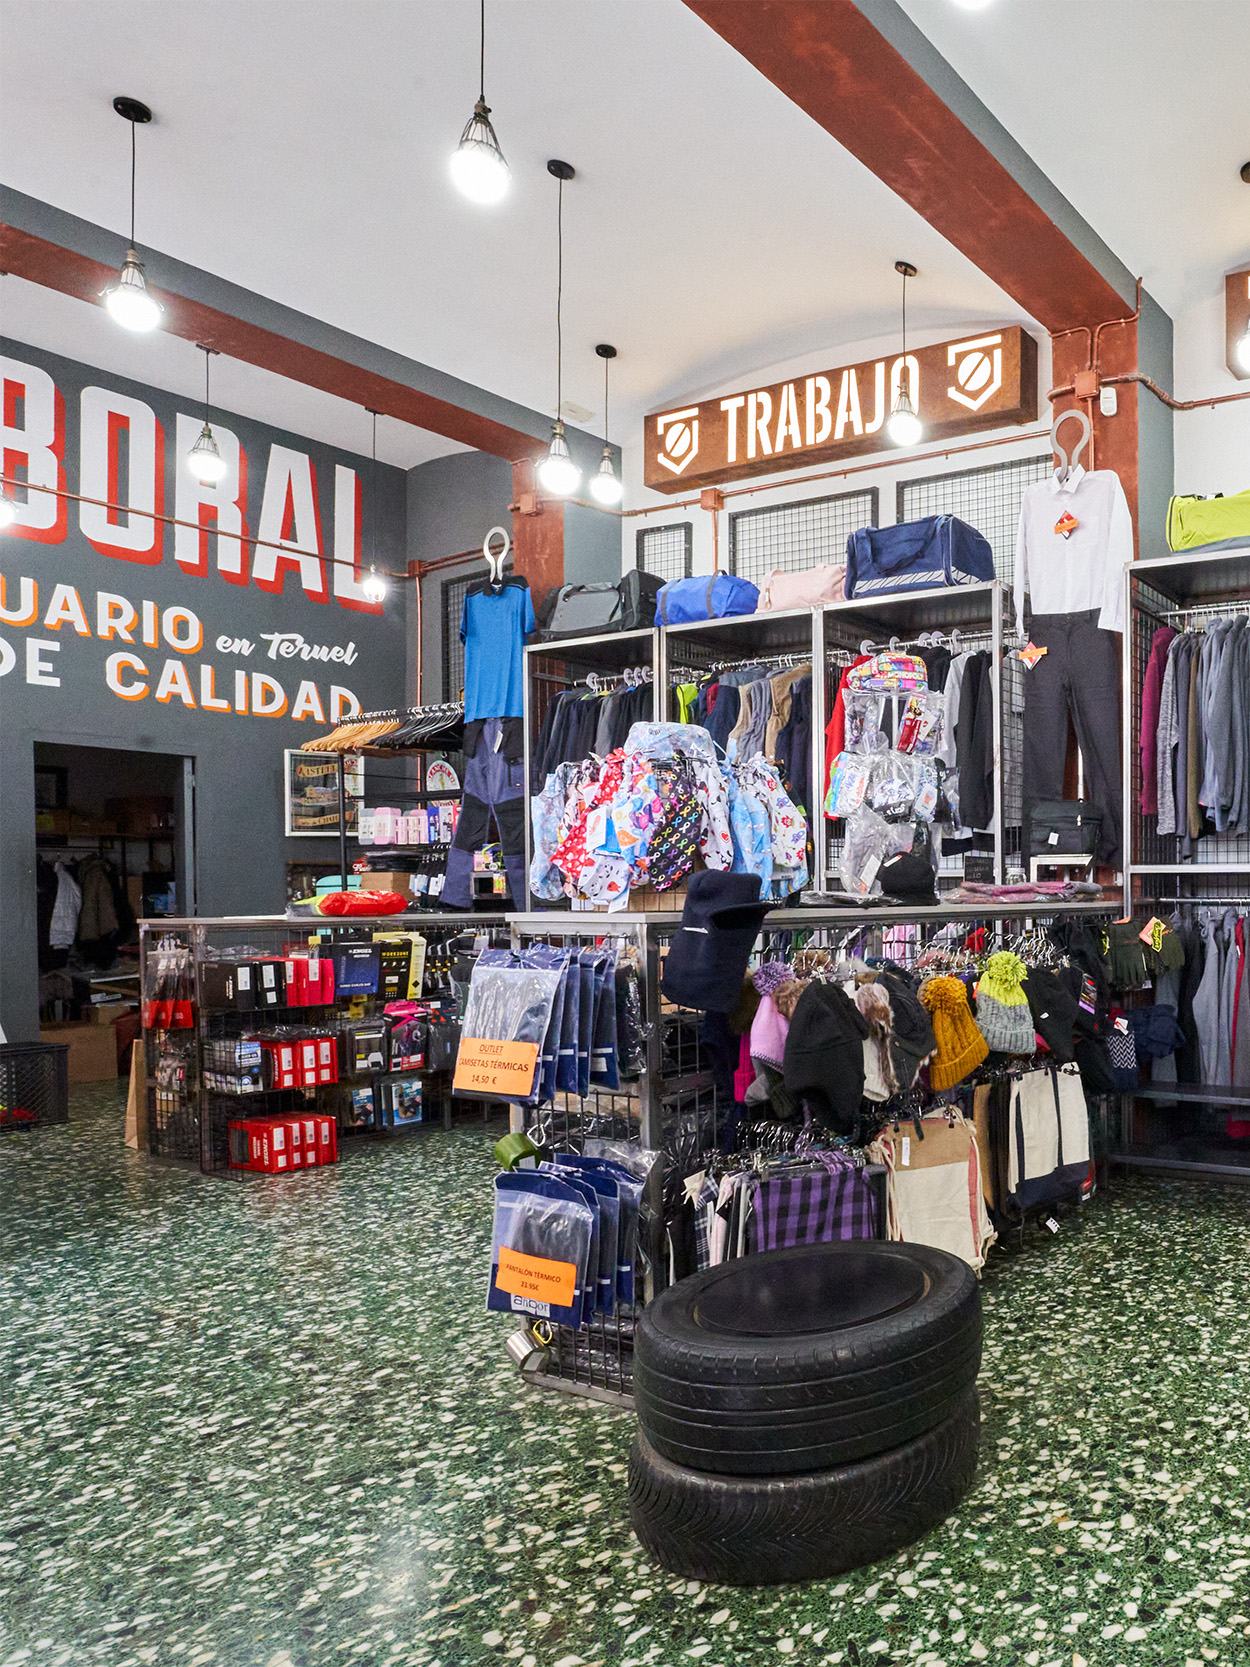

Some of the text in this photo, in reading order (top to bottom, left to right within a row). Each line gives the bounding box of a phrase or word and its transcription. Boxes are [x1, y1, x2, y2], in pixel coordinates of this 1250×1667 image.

[720, 355, 920, 464] TRABAJO
[0, 355, 381, 608] BORAL
[216, 634, 254, 656] en
[260, 632, 358, 666] Teruel
[106, 651, 363, 724] CALIDAD
[459, 1058, 529, 1072] CAMISETAS TÉRMICAS
[479, 1044, 504, 1054] OUTLET
[471, 1075, 490, 1085] 14,50
